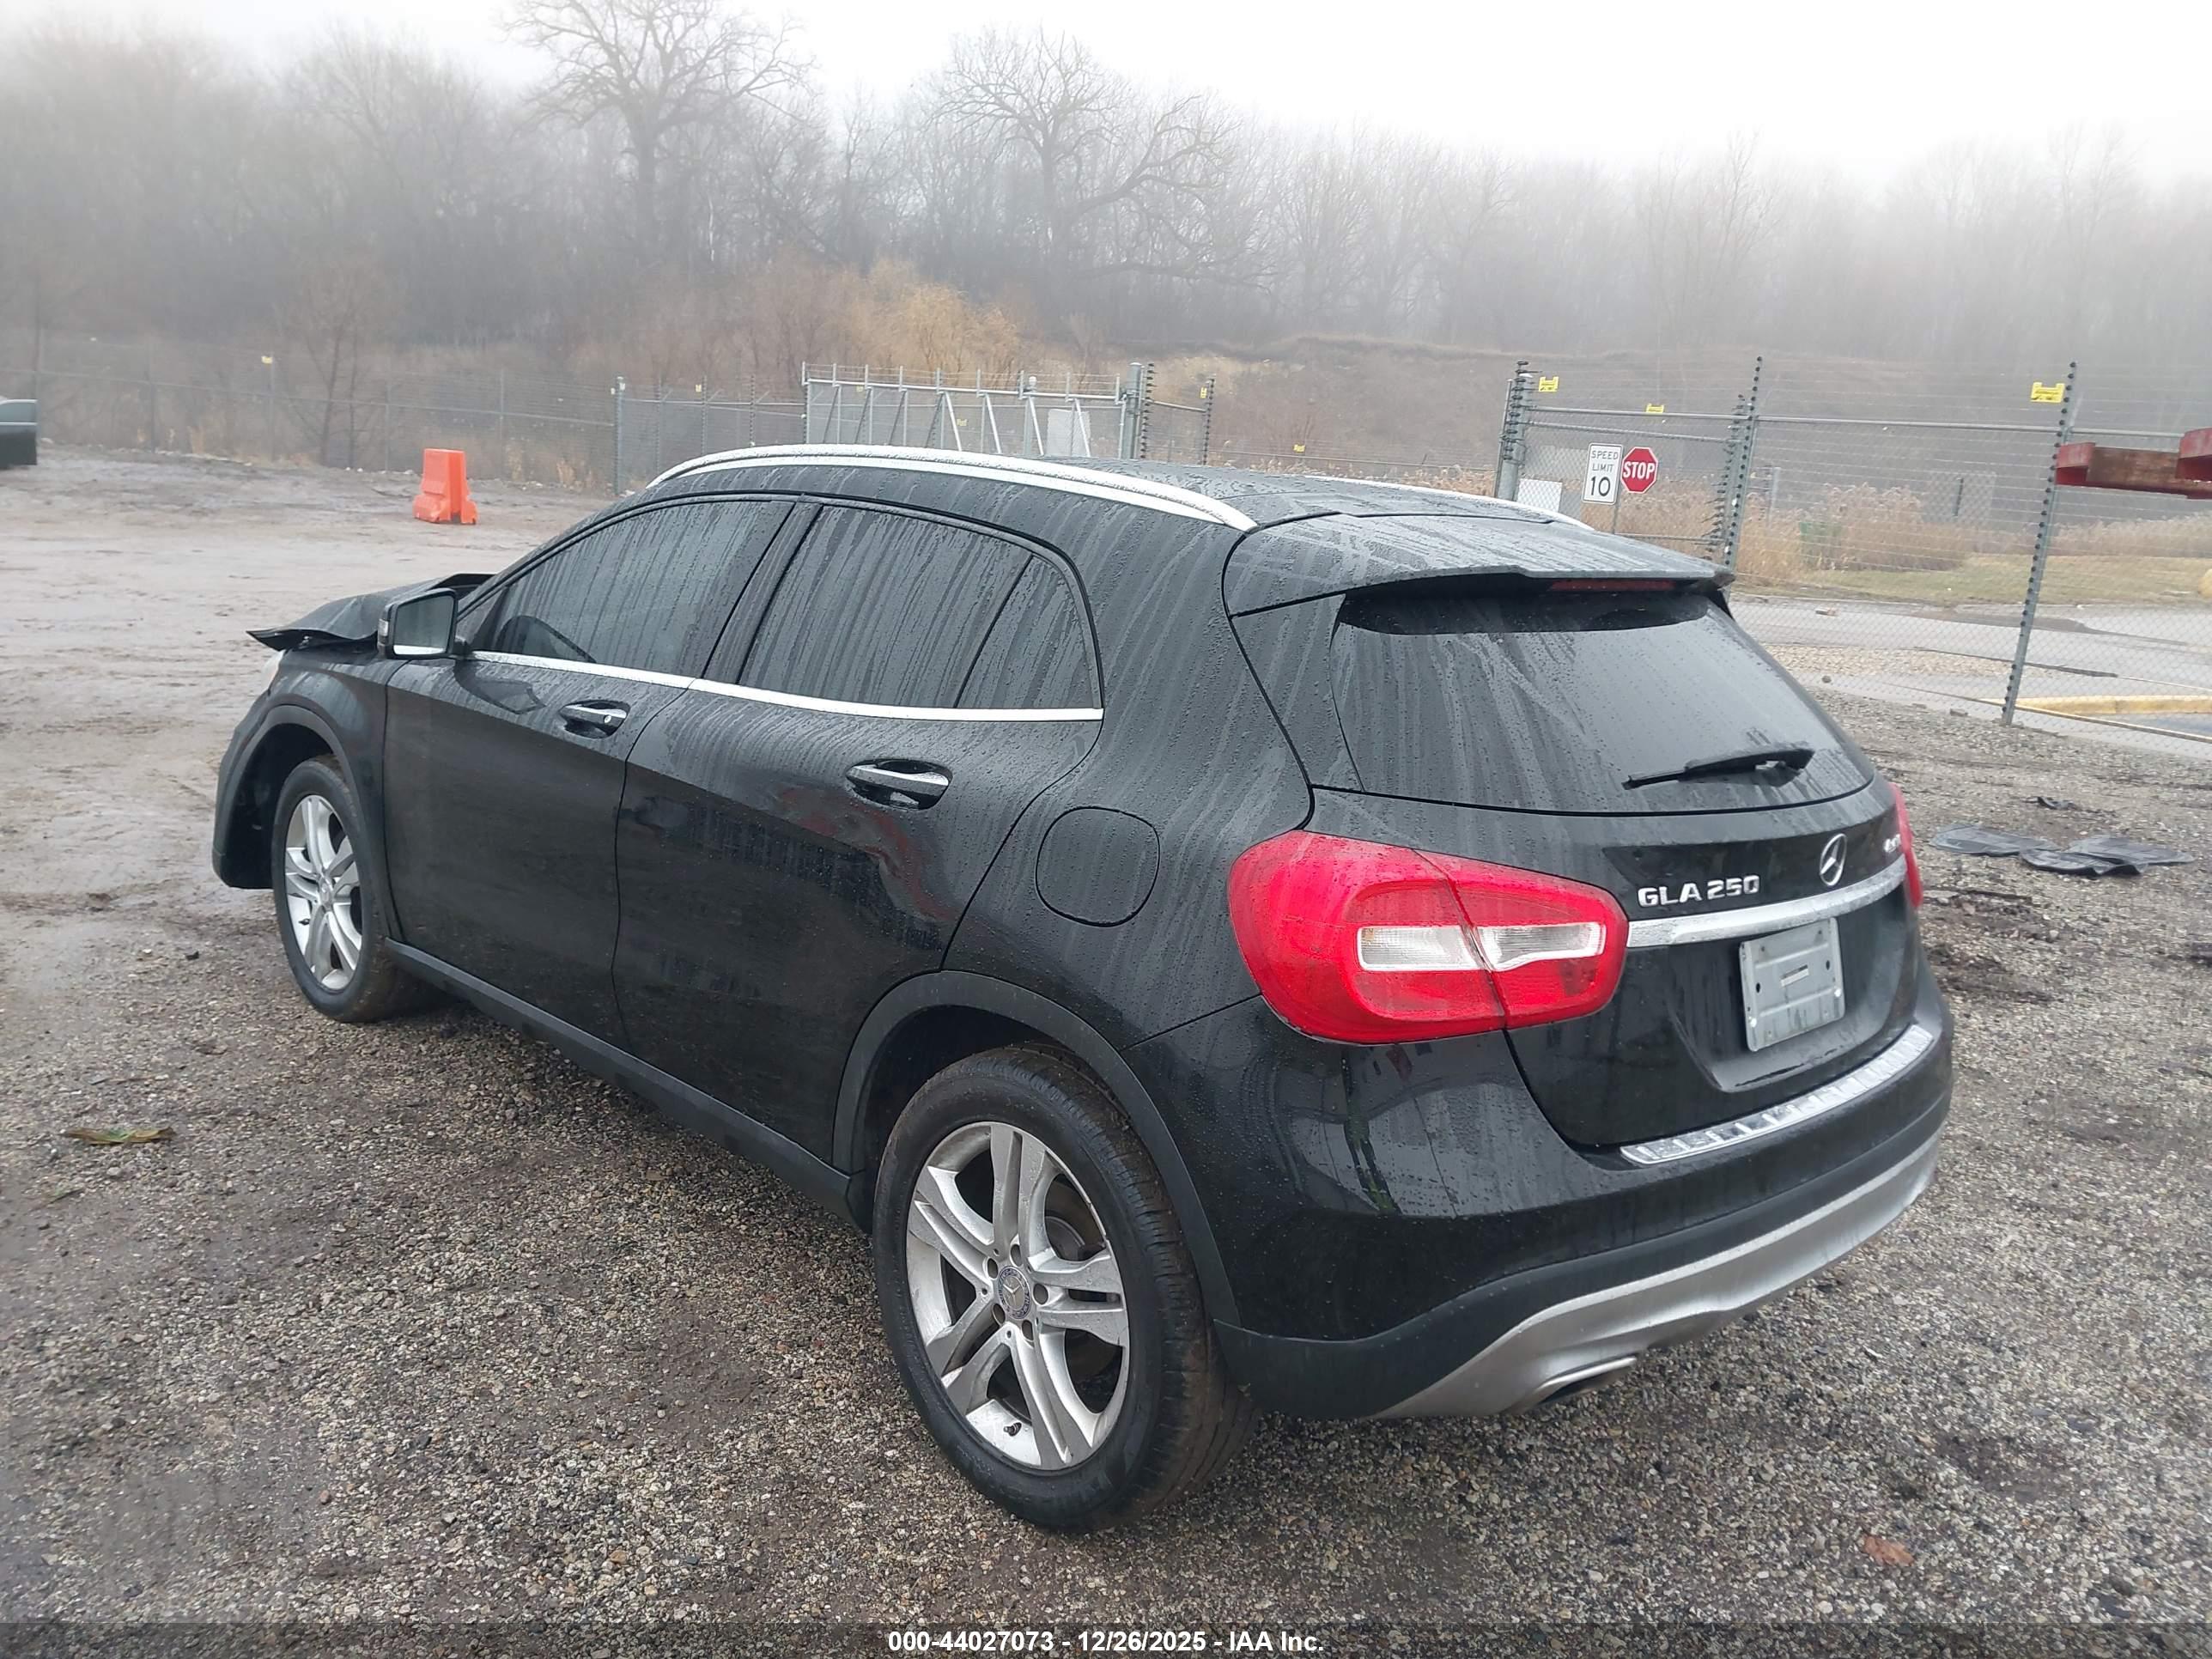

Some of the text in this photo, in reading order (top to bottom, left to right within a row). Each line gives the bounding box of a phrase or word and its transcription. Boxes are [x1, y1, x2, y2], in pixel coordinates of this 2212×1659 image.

[1591, 450, 1619, 459] SPEED
[1592, 463, 1614, 472] LIMIT
[1623, 461, 1656, 479] STOP
[1590, 476, 1611, 497] 10
[1638, 875, 1760, 907] GLA 250
